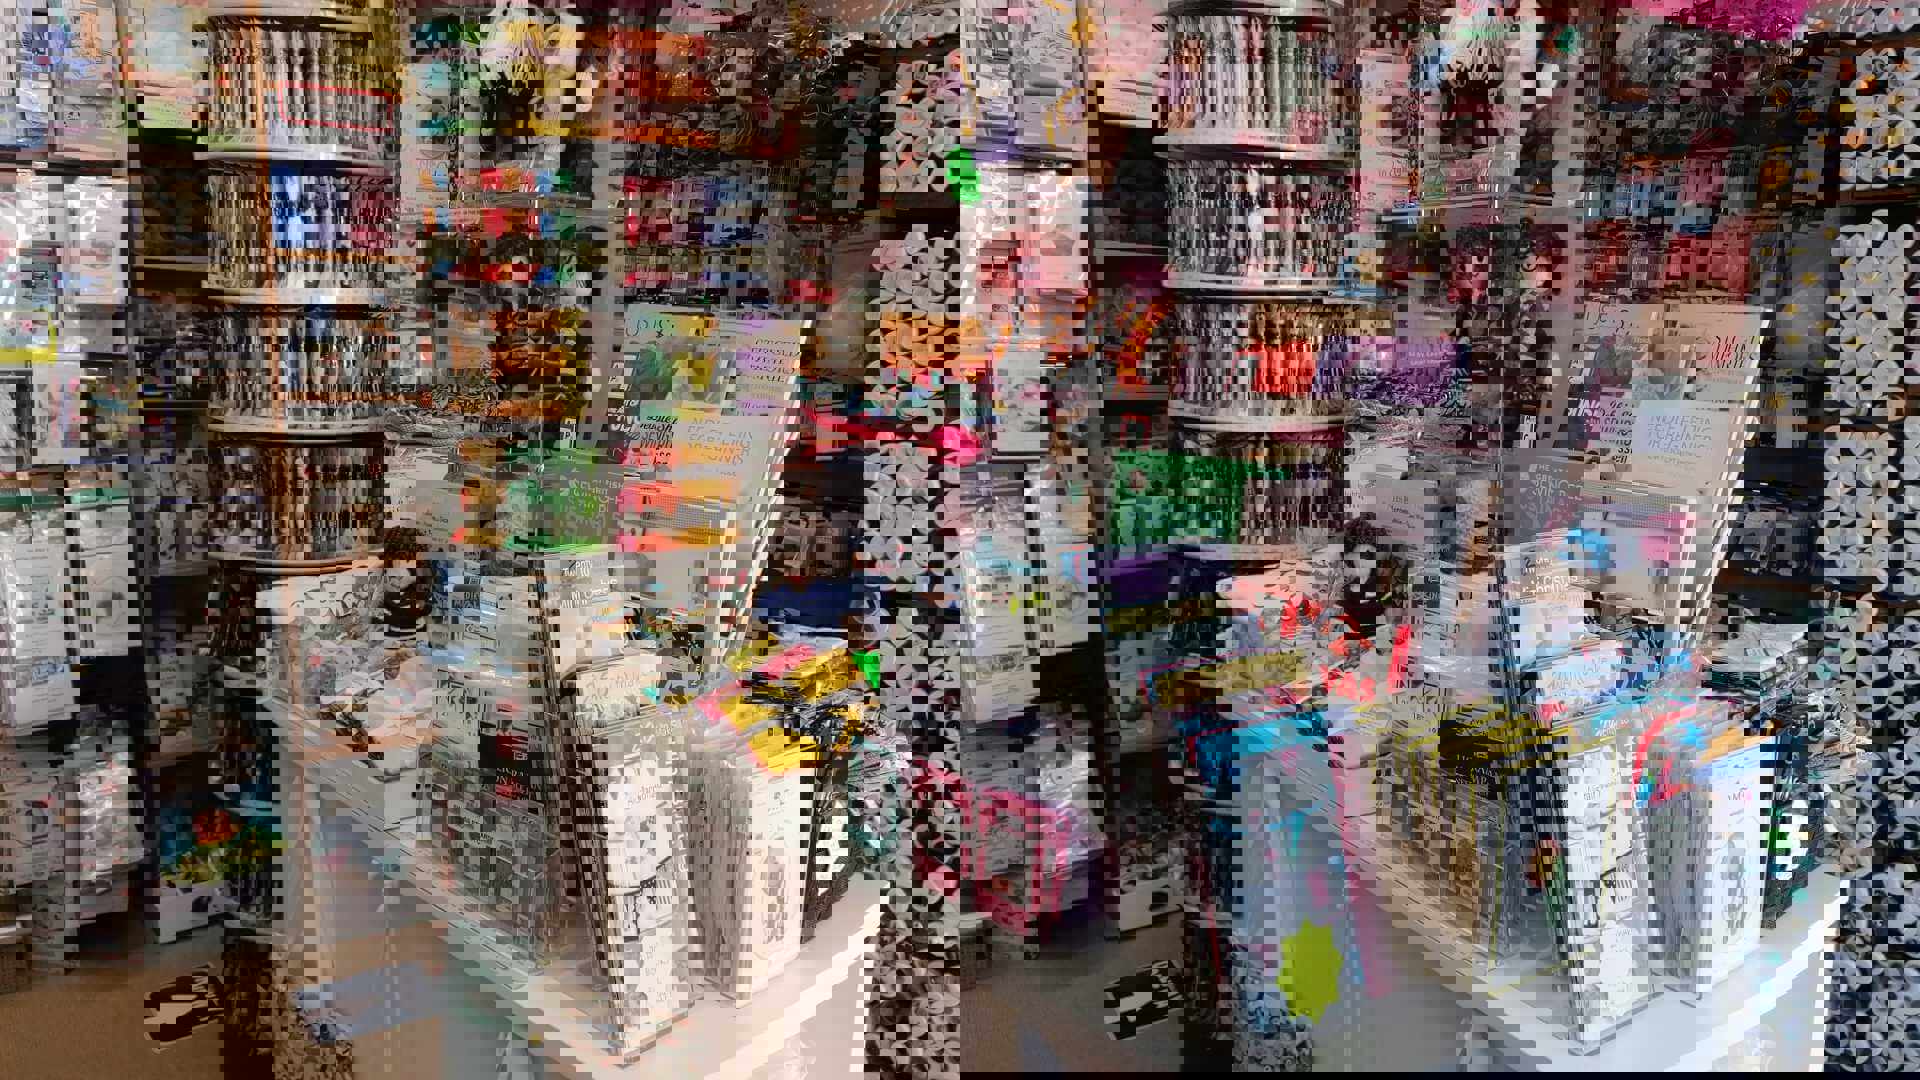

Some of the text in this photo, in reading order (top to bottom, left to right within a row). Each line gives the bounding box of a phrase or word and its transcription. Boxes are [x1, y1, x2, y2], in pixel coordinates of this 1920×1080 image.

[1258, 310, 1304, 333] JUST
[1504, 339, 1586, 357] STITCHED
[1500, 357, 1581, 375] MEMORIES
[1286, 408, 1328, 424] Debbie
[1281, 425, 1326, 444] SEWING
[1379, 417, 1503, 441] NEEDLE FELTING
[1376, 434, 1496, 458] FOR BEGINNERS
[1150, 470, 1233, 490] THE GREAT BRITISH
[782, 497, 805, 509] Gift
[1148, 480, 1232, 509] SEWING BEE
[1127, 494, 1229, 526] SUSTAINABLE
[1124, 510, 1228, 541] STYLE
[1171, 557, 1182, 570] to
[1130, 577, 1226, 604] Mini Christmas
[1239, 670, 1252, 685] to
[1256, 664, 1288, 681] Make
[1320, 663, 1377, 701] VAS
[1316, 723, 1326, 733] to
[1327, 718, 1349, 732] Make
[1335, 741, 1354, 783] Mini
[992, 762, 1078, 792] LION RAMPANT
[1251, 778, 1318, 804] Alistair Macdonald
[1547, 788, 1574, 806] DMC
[1343, 789, 1363, 874] Bunting
[382, 968, 434, 1014] ONE WAY
